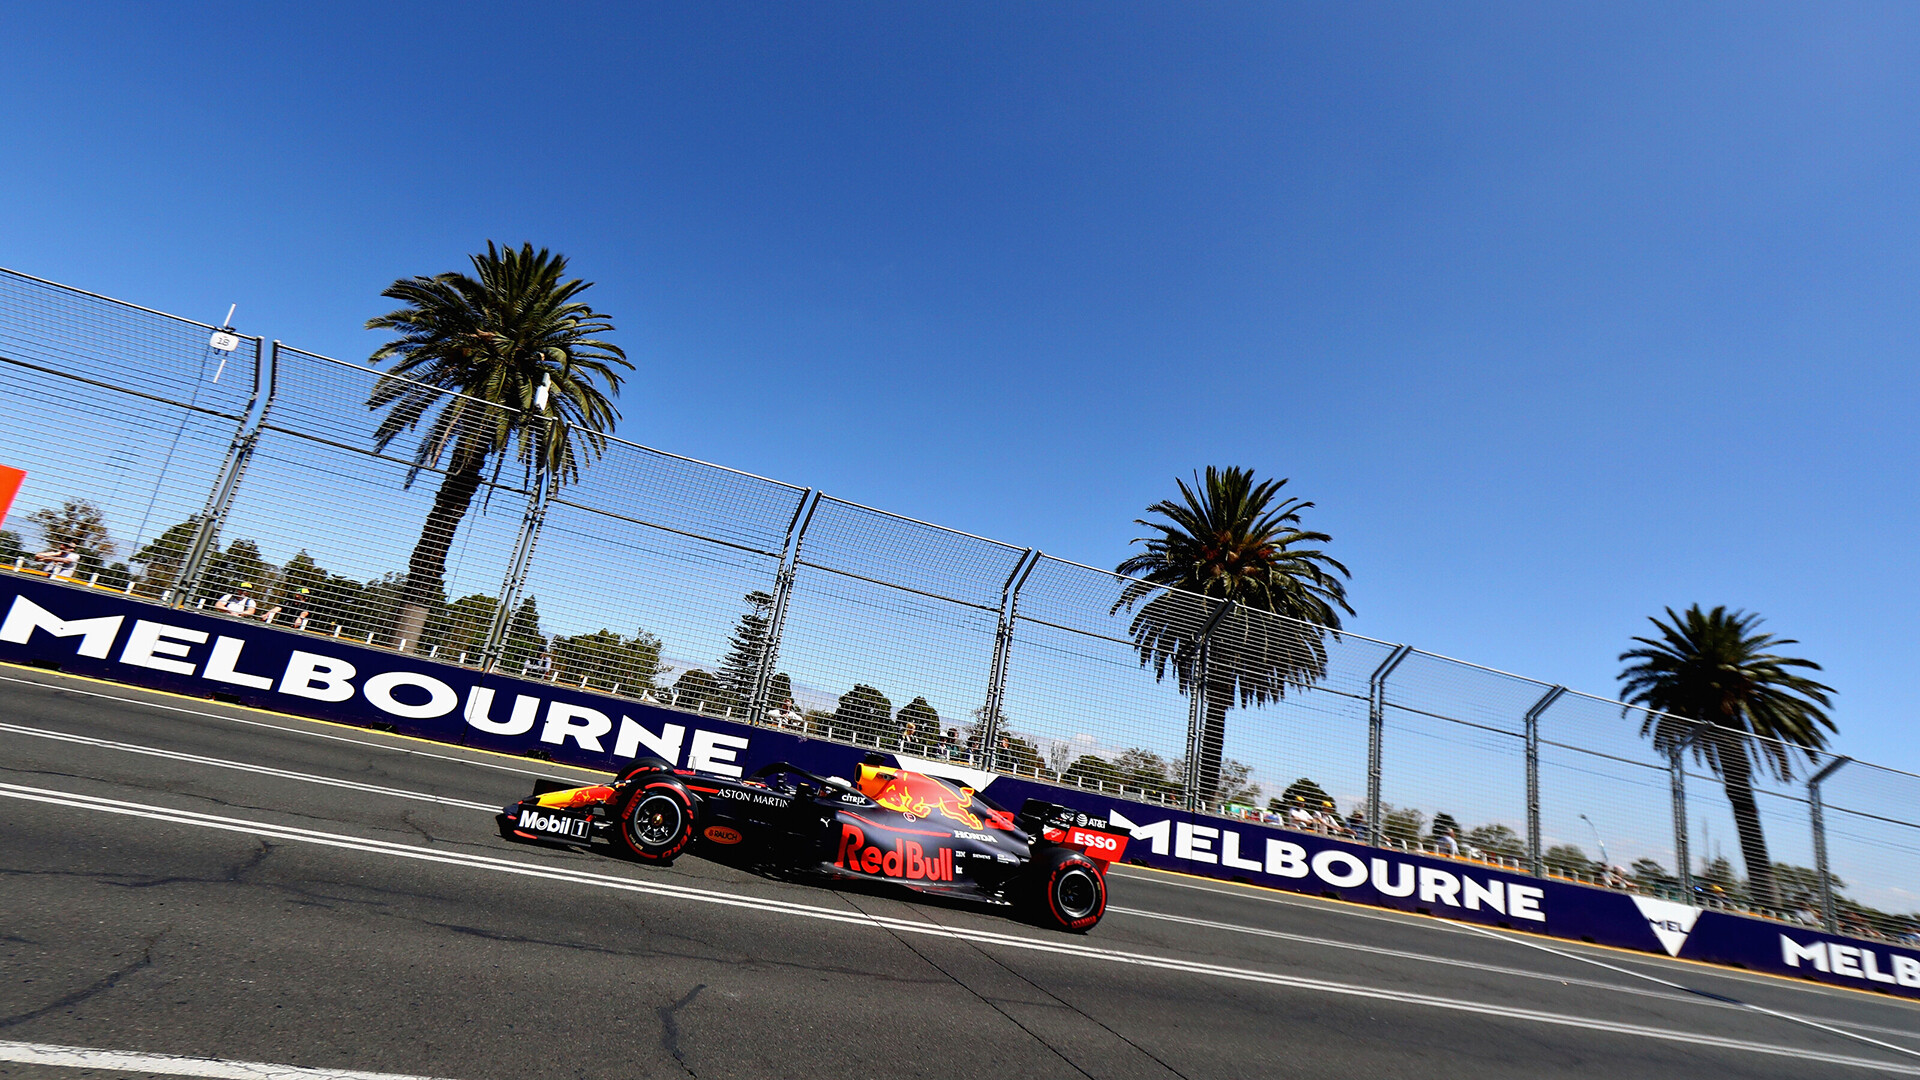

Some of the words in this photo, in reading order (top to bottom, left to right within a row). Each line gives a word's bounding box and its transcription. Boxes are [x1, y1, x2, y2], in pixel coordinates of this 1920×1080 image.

[0, 594, 749, 777] MELBOURNE
[717, 788, 751, 802] ASTON
[753, 794, 790, 808] MARTIN
[519, 809, 572, 835] Mobil
[1088, 817, 1108, 829] AT&T
[714, 830, 738, 841] RAUCH
[953, 829, 998, 843] HONDA
[1074, 832, 1117, 851] ESSO
[1109, 808, 1546, 922] MELBOURNE
[1649, 917, 1690, 935] MEL
